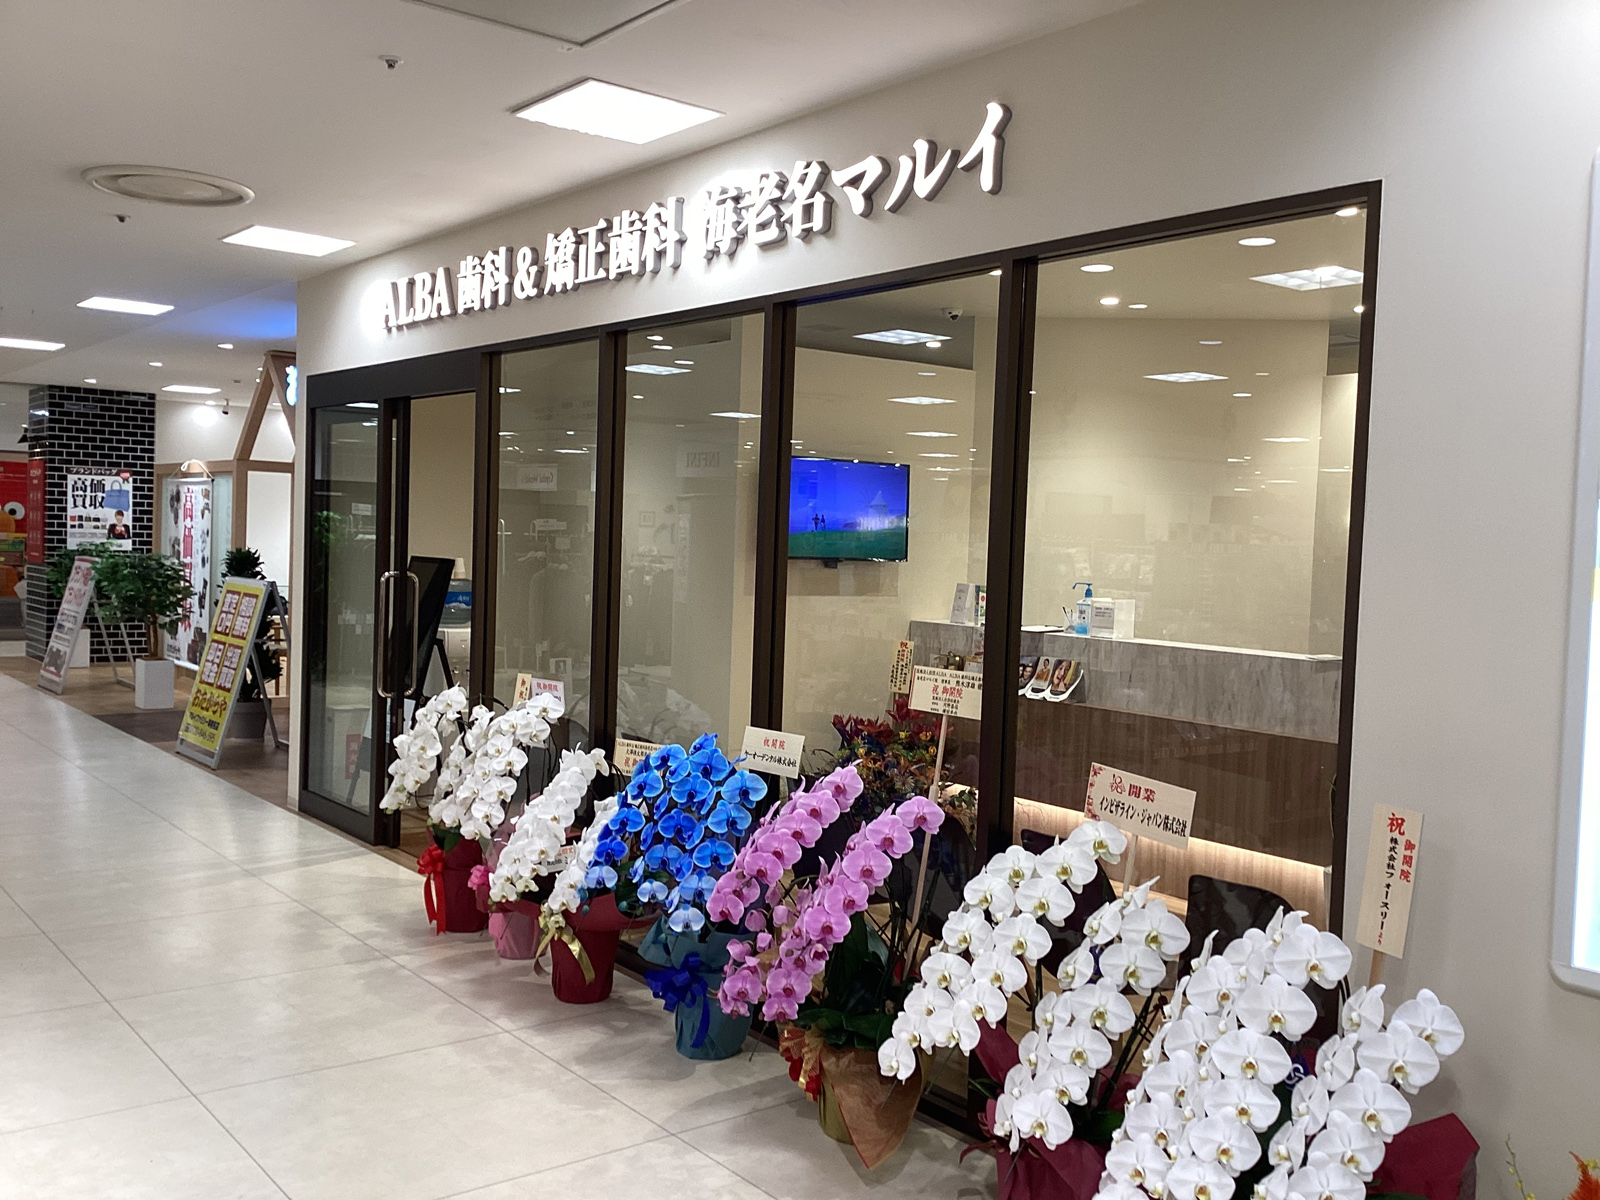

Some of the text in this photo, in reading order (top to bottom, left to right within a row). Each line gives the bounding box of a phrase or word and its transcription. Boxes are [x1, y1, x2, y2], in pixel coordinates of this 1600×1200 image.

[384, 266, 455, 330] ALBA
[703, 101, 1011, 260] 海老名マルイ
[70, 467, 118, 475] ブランドバッグ
[71, 477, 106, 494] 高価
[71, 494, 106, 509] 買取
[1127, 783, 1156, 803] 開業
[1387, 812, 1406, 836] 祝
[1399, 839, 1416, 883] 御開院
